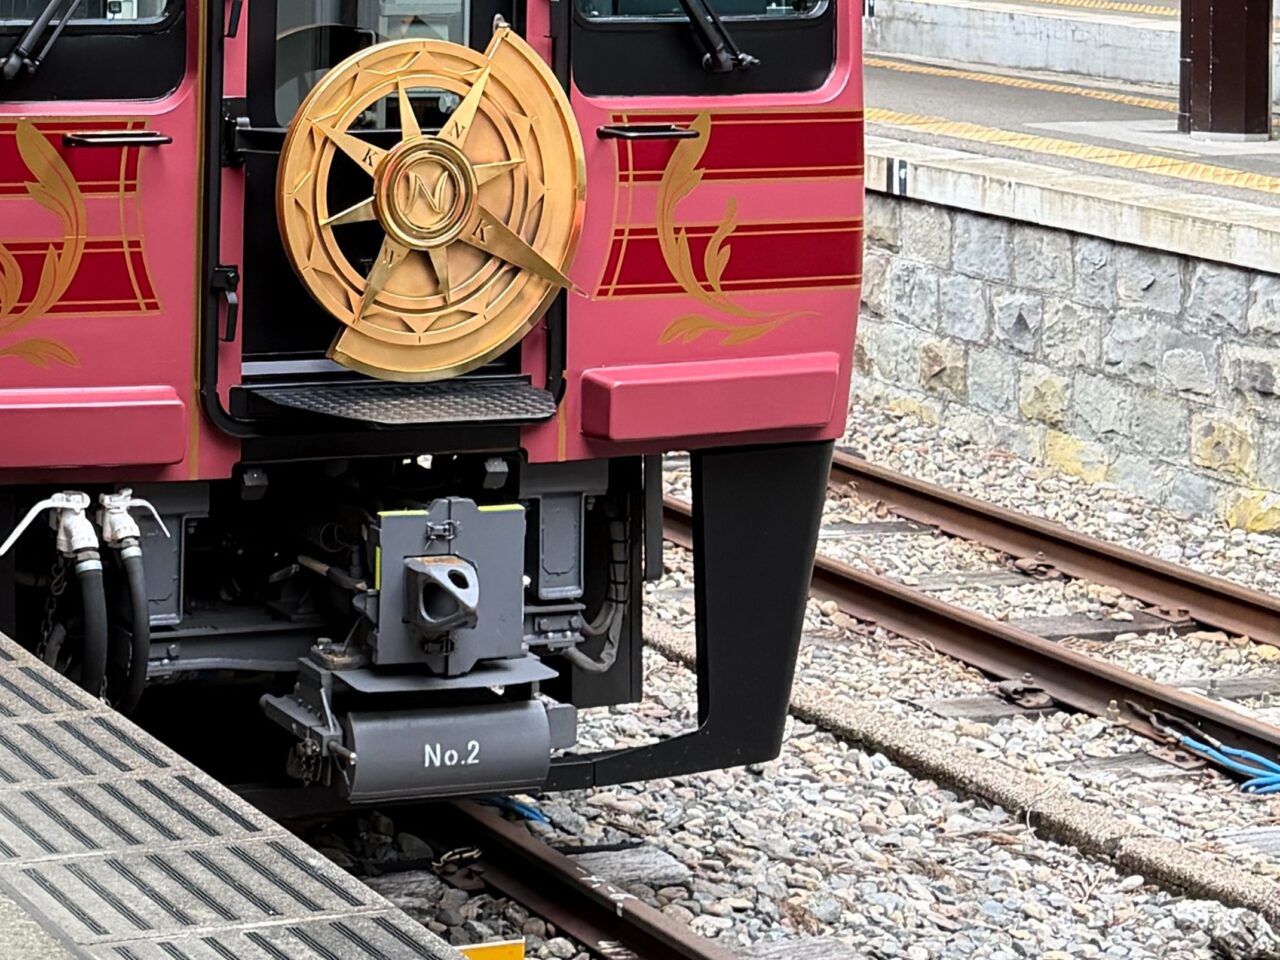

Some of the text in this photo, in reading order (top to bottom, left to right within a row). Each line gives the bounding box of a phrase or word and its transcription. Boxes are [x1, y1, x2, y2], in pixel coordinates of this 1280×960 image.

[362, 148, 380, 167] K
[406, 171, 449, 214] N
[472, 218, 493, 242] K
[424, 739, 480, 767] No.2
